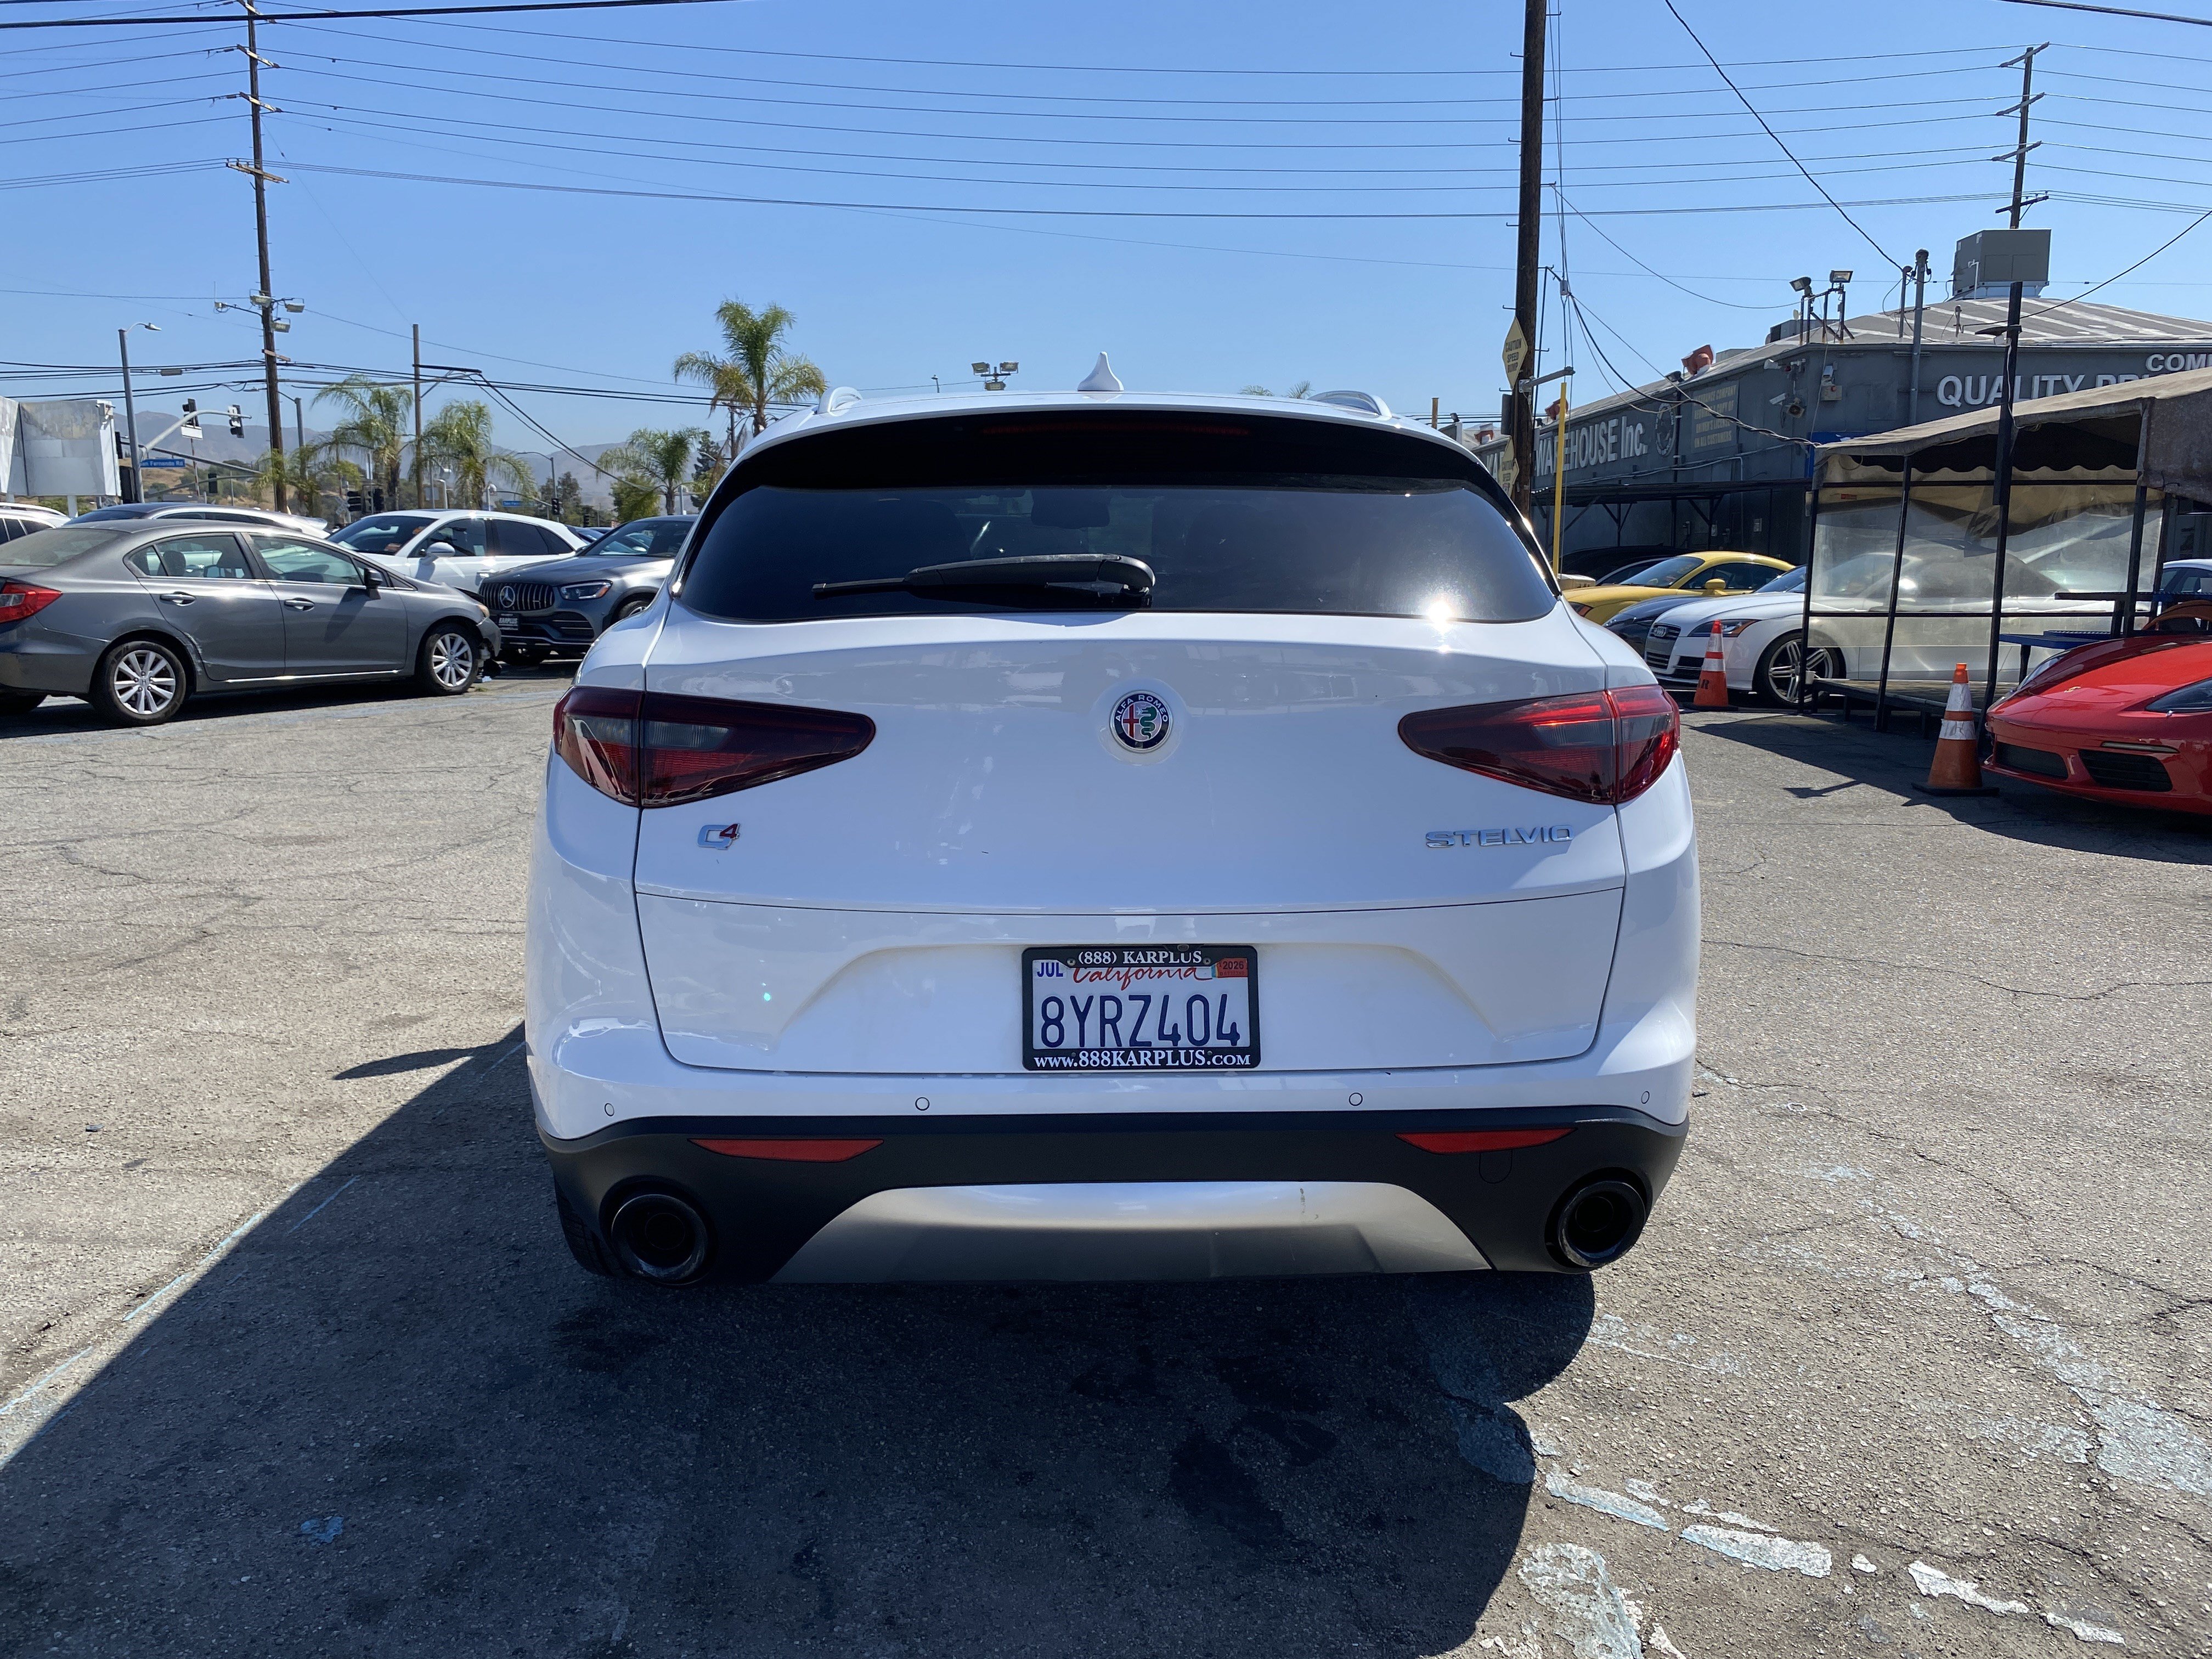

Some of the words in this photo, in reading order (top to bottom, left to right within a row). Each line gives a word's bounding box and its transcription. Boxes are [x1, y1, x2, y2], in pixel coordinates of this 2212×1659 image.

[1507, 352, 1519, 363] SPEED
[1937, 375, 2085, 408] QUALITY
[1621, 416, 1648, 459] Inc.
[1115, 698, 1133, 721] ALFA
[1138, 695, 1168, 722] ROMEO
[1426, 825, 1575, 848] STELVIO
[1078, 951, 1117, 964] (888)
[1122, 950, 1202, 964] KARPLUS
[1037, 962, 1064, 977] JUL
[1073, 967, 1214, 991] California
[1222, 961, 1244, 969] 2026
[1041, 993, 1240, 1048] 8YRZ404
